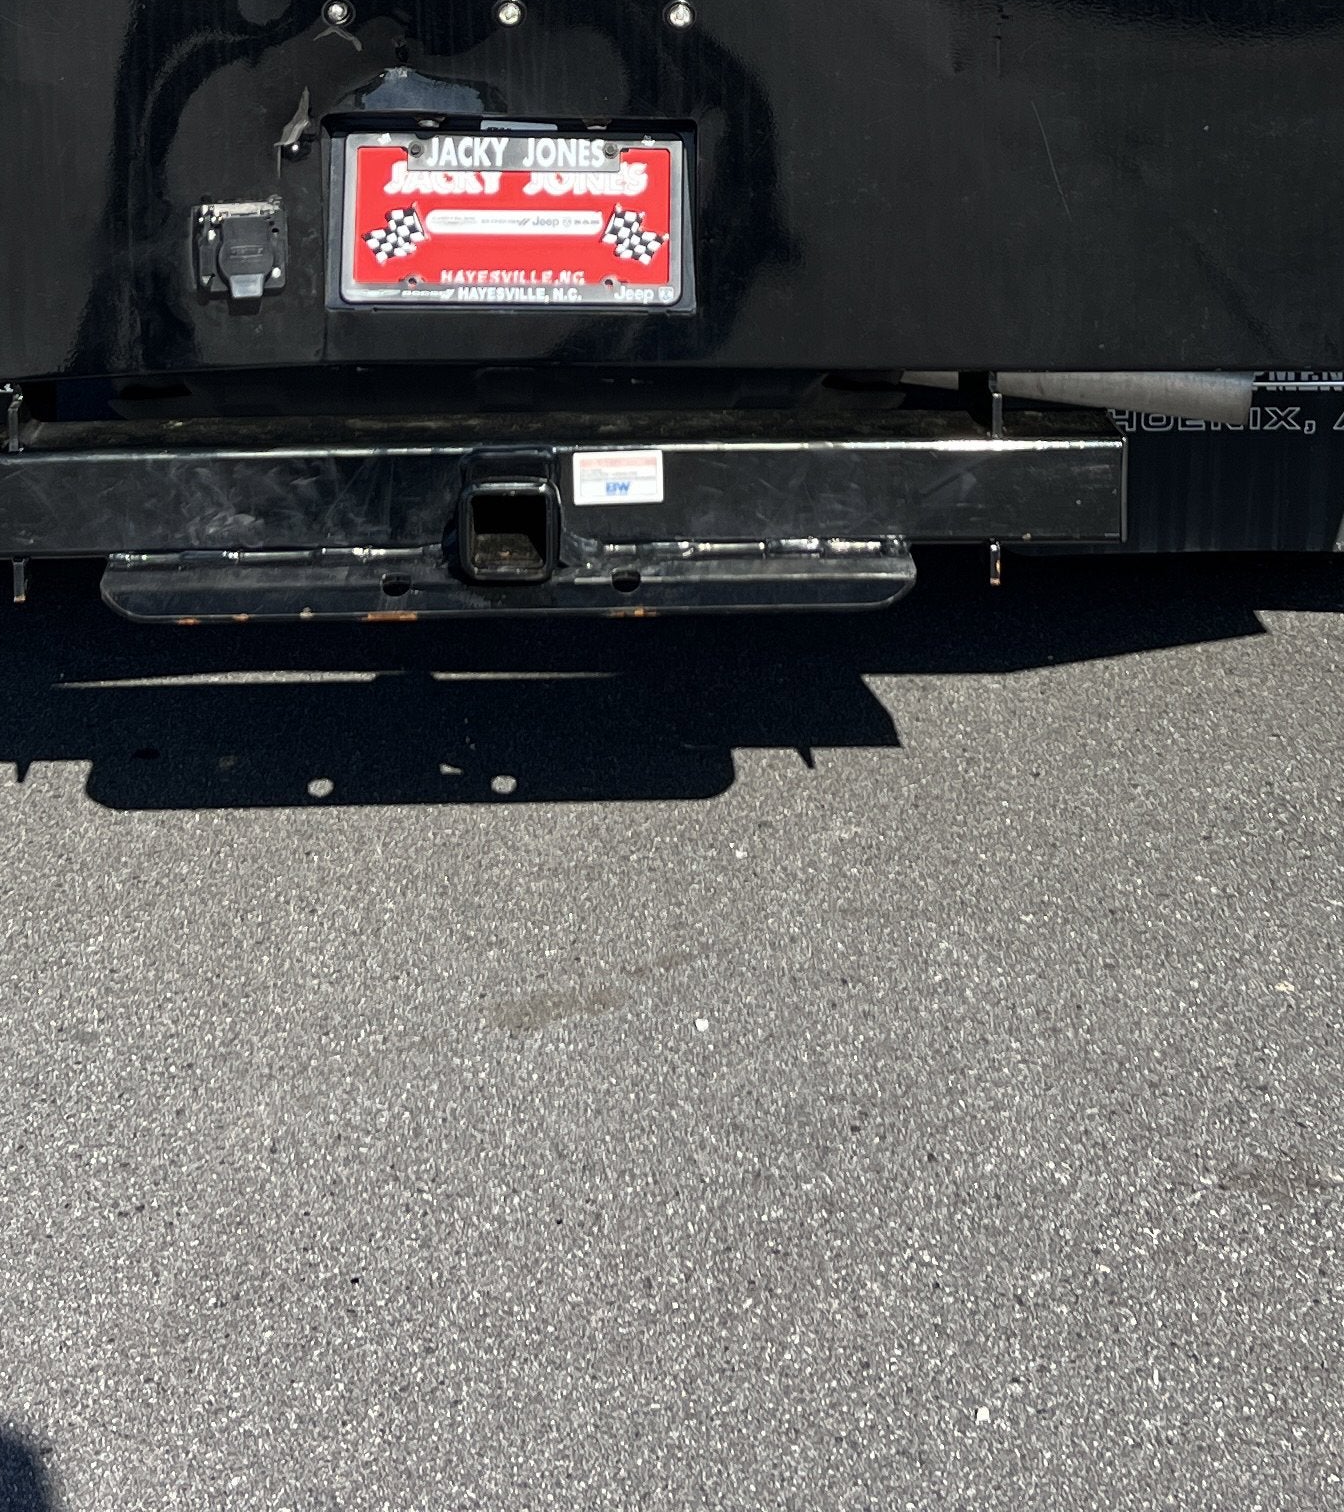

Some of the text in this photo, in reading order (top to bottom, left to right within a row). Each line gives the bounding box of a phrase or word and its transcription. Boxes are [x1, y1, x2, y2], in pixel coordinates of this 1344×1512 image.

[427, 138, 605, 168] JACKY JONES
[532, 216, 559, 227] Jeep
[614, 287, 654, 303] Jeep
